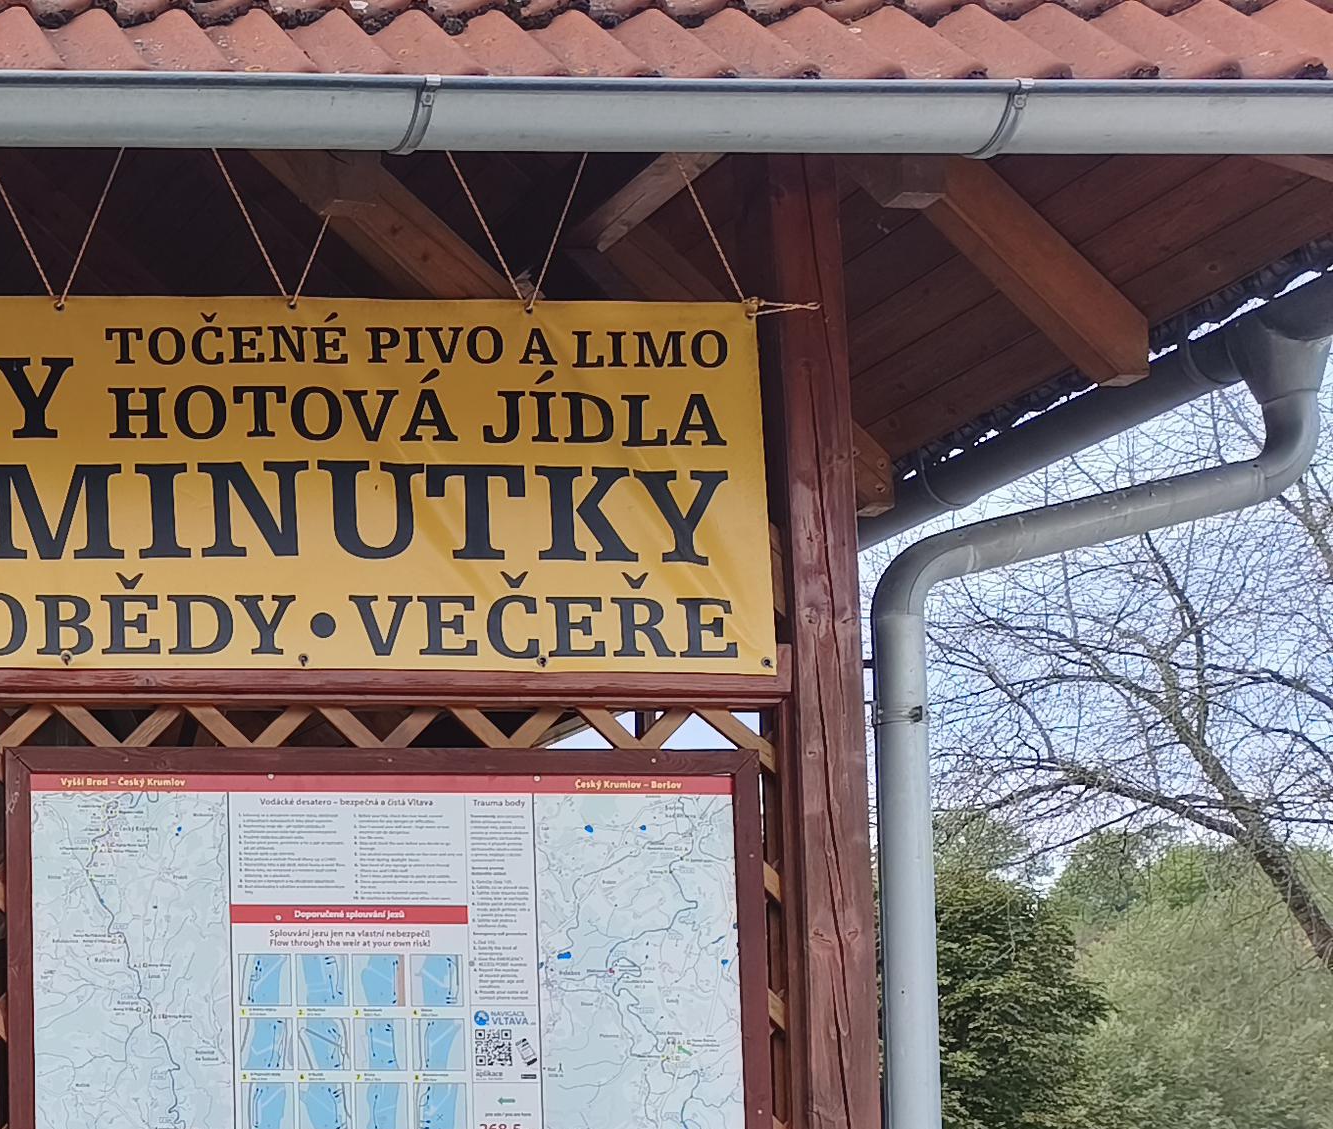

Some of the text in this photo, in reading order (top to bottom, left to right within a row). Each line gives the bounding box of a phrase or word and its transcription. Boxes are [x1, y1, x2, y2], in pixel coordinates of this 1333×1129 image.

[105, 312, 729, 368] TOČENÉ PIVO A LIMO
[107, 369, 727, 447] HOTOVÁ JÍDLA
[86, 777, 108, 786] Brod
[118, 776, 144, 787] Český
[146, 777, 186, 786] Krumlov
[575, 779, 602, 790] Český
[604, 780, 641, 788] Krumlov
[296, 798, 331, 806] desatero
[340, 798, 379, 807] bezpečná
[388, 798, 406, 806] čistá
[408, 798, 433, 806] Vltava
[505, 799, 525, 808] body
[294, 910, 404, 920] Doporučené splouvání jezů
[270, 930, 310, 938] Splouvání
[312, 930, 329, 938] jezu
[330, 930, 343, 938] jen
[386, 930, 430, 938] nebezpečí!
[270, 939, 289, 947] Flow
[291, 939, 324, 948] through
[326, 939, 340, 947] the
[410, 939, 430, 947] risk!
[492, 1017, 528, 1025] VLTAVA
